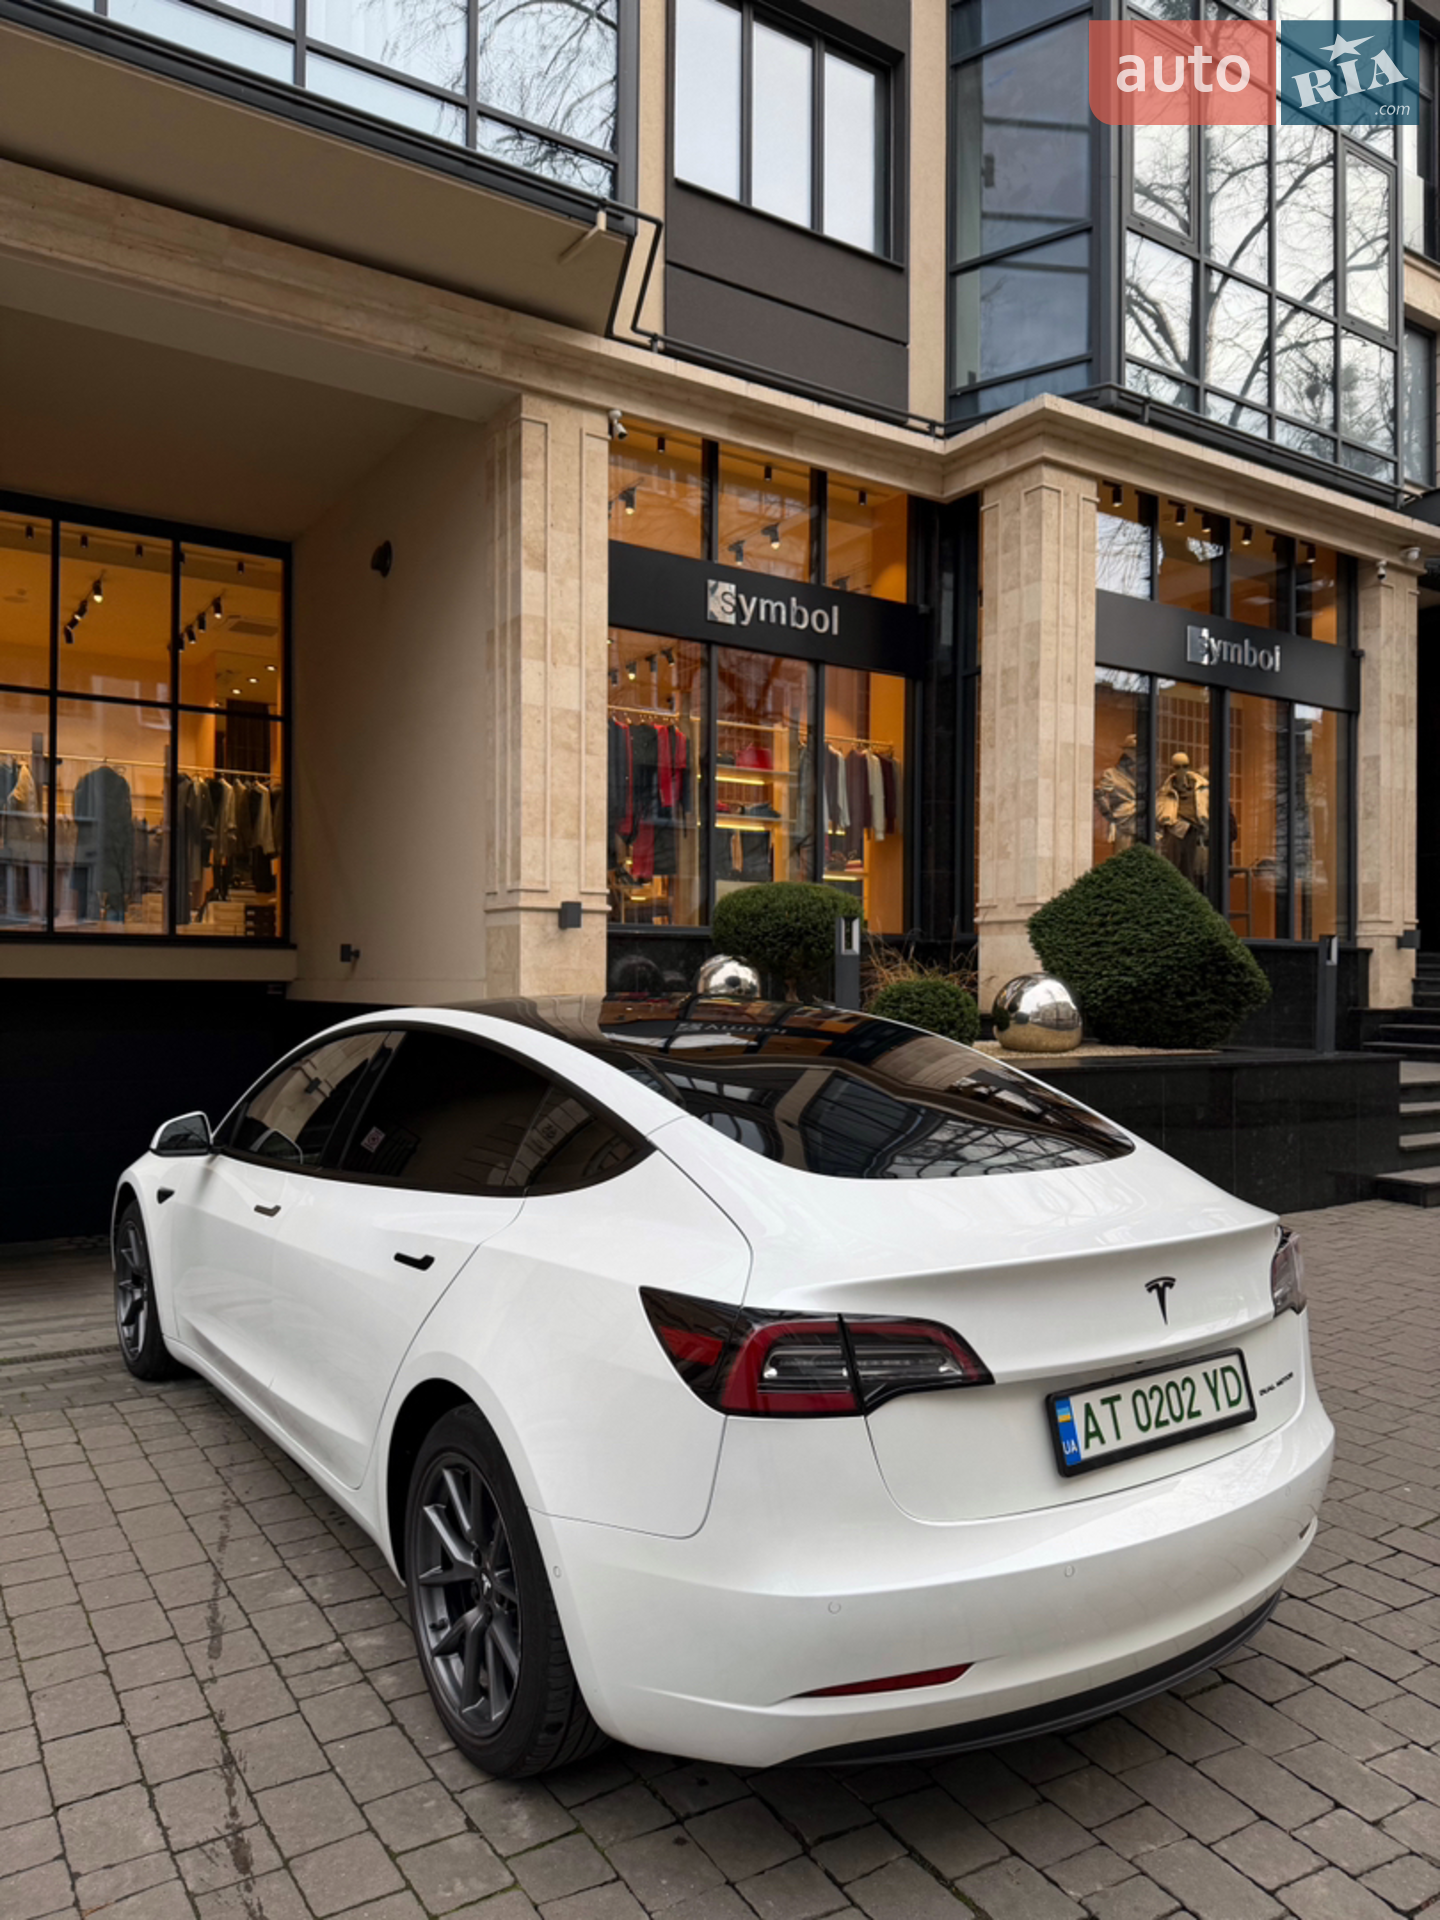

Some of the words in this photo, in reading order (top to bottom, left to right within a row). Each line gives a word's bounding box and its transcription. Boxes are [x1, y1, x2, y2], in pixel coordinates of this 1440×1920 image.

[717, 588, 839, 636] symbol
[1084, 1393, 1122, 1450] AT
[1131, 1376, 1202, 1433] 0202
[1202, 1365, 1243, 1411] YD
[1062, 1439, 1079, 1455] UA
